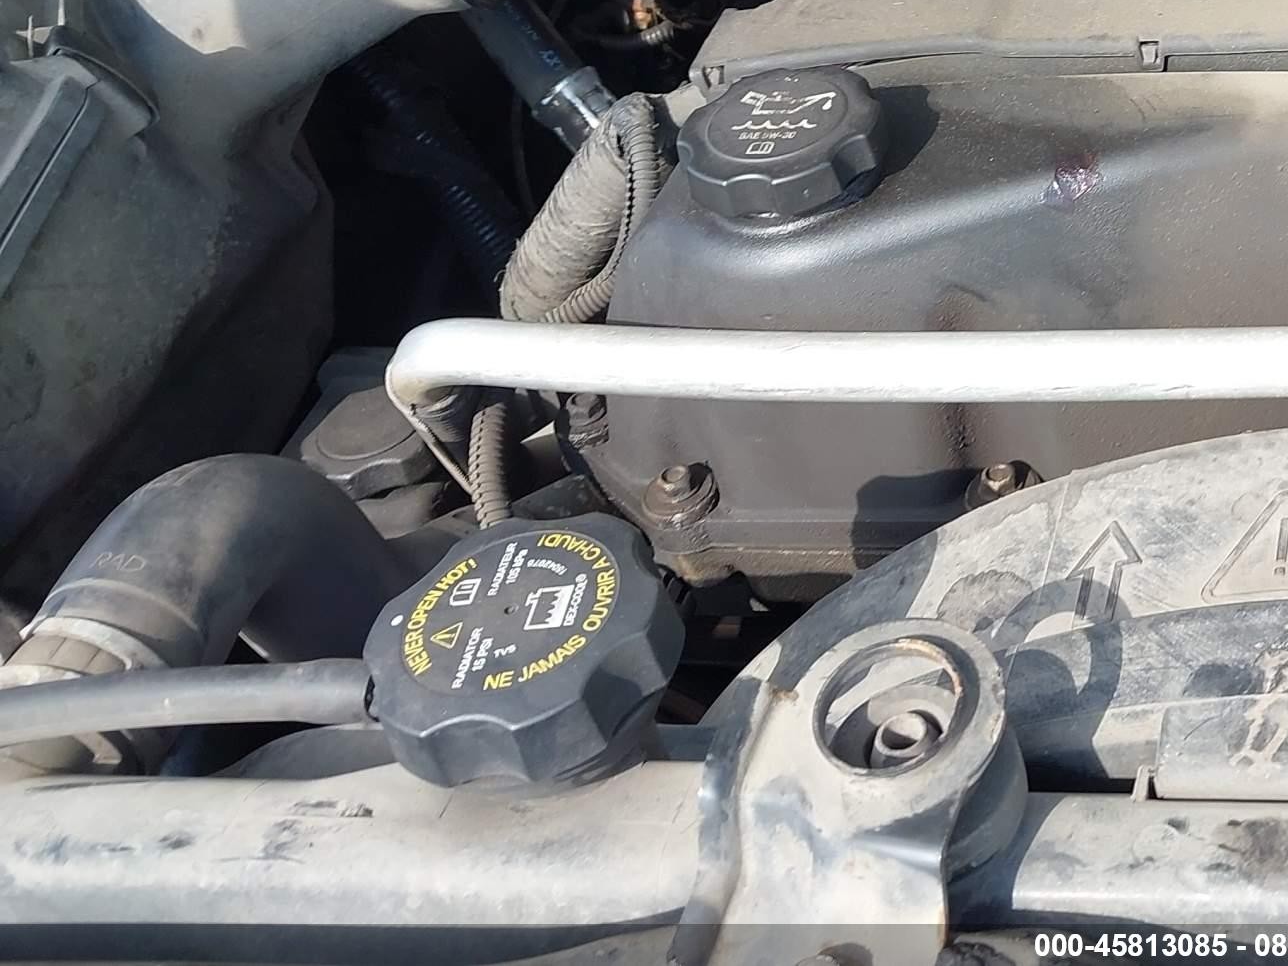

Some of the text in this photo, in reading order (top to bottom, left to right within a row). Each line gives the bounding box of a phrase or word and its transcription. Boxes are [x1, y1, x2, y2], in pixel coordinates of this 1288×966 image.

[487, 542, 518, 596] RADIATEUR
[404, 558, 478, 676] NEVER OPEN HOT!
[483, 670, 515, 691] NE
[518, 634, 587, 682] JAMAIS
[582, 568, 615, 632] OUVRIR
[451, 627, 484, 690] RADIATOR
[471, 637, 494, 672] 15 PSI
